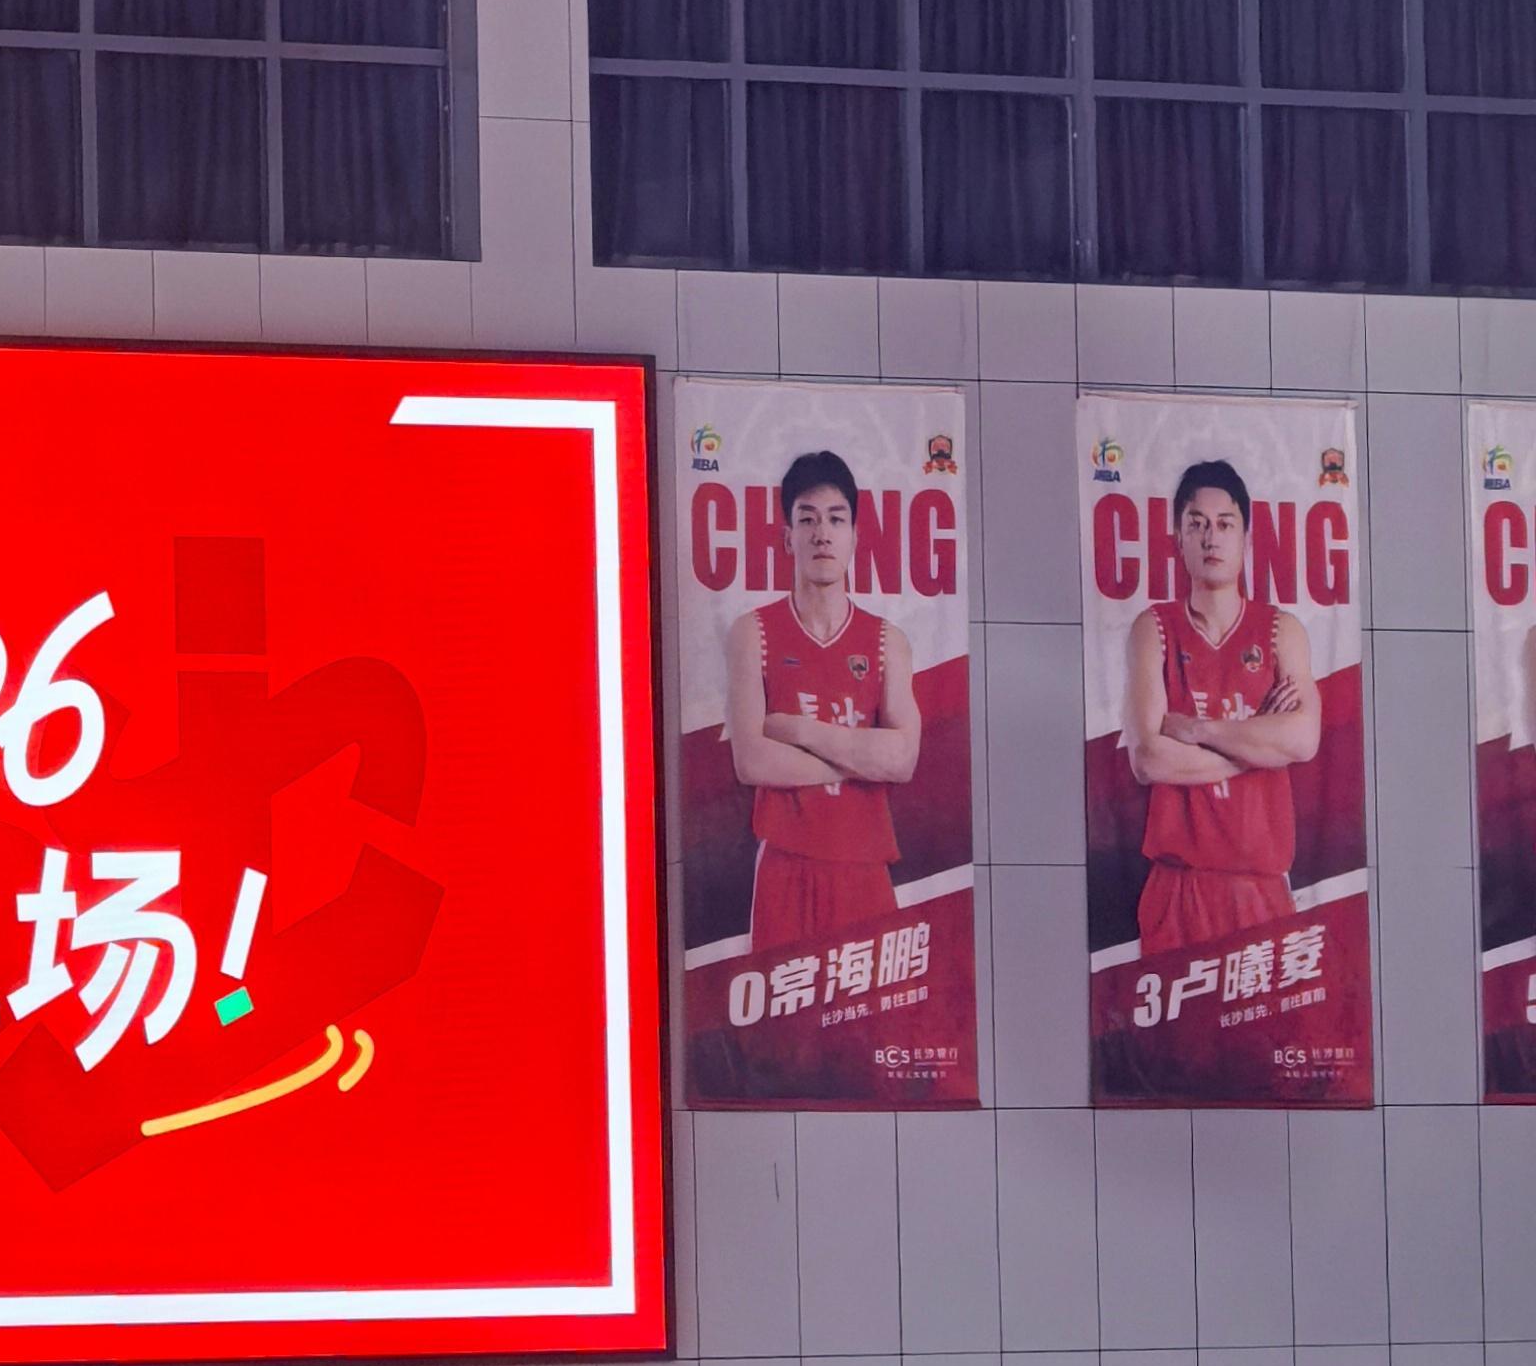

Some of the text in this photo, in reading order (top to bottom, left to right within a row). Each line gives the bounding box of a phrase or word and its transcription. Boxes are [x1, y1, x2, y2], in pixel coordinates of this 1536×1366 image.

[691, 482, 957, 597] CHNG
[1093, 493, 1350, 606] CHNG
[875, 1047, 910, 1067] BCS
[1274, 1047, 1306, 1066] BCS
